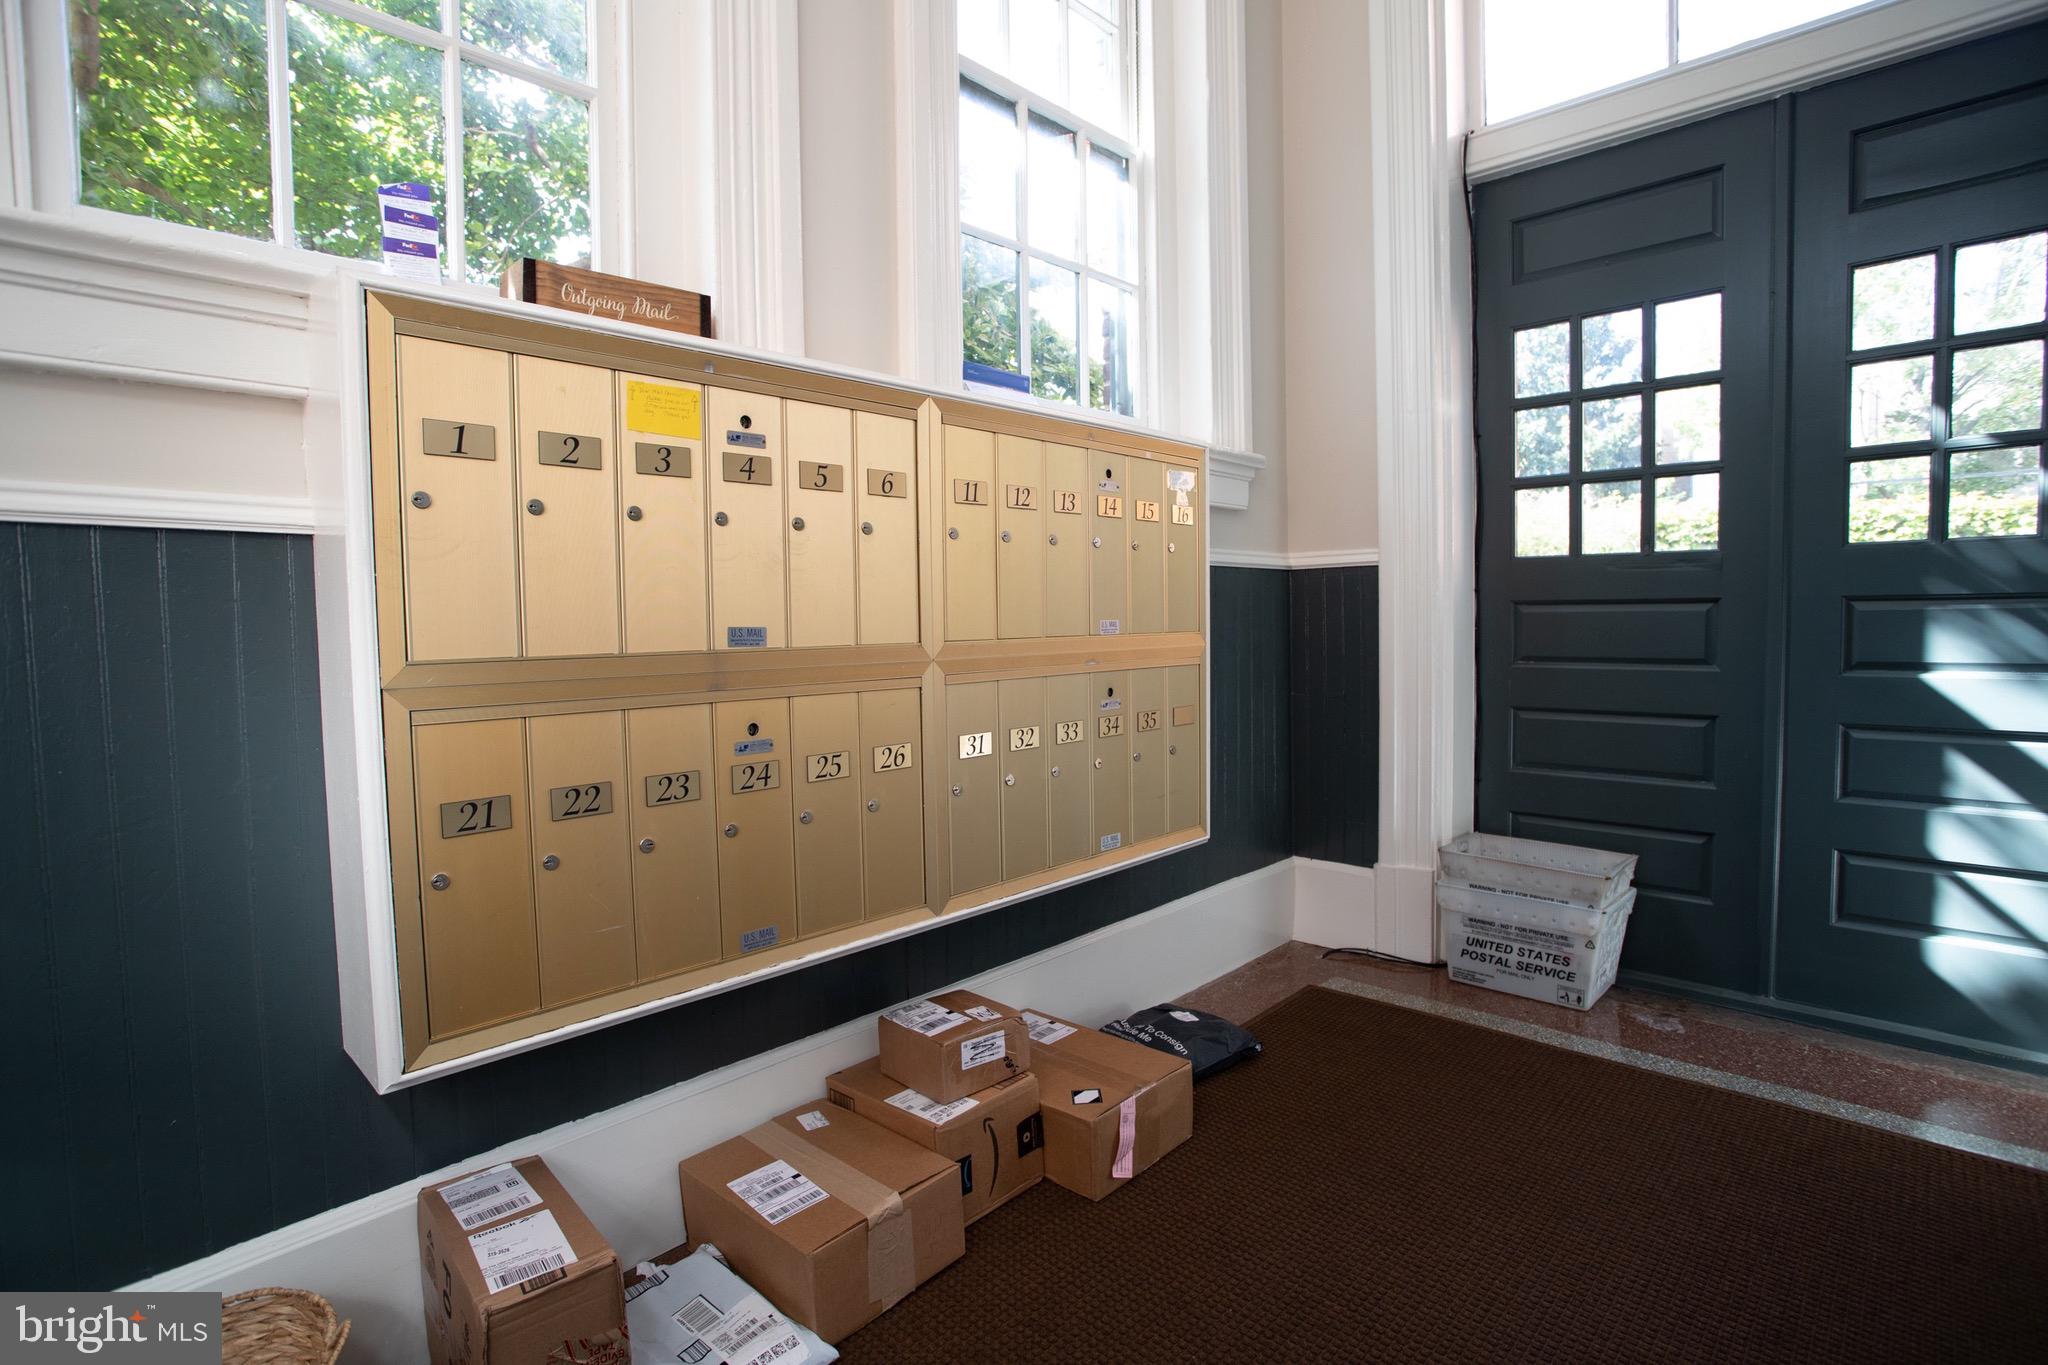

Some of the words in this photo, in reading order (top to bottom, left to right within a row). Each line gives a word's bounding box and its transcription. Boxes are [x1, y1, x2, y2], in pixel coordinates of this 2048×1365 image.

[561, 282, 626, 320] Outgoing
[632, 296, 679, 320] Mail
[450, 425, 468, 454] 1
[559, 436, 580, 464] 2
[654, 447, 672, 473] 3
[739, 457, 756, 481] 4
[814, 464, 829, 488] 5
[881, 472, 894, 495] 6
[962, 481, 979, 503] 11
[1013, 487, 1031, 507] 12
[1061, 492, 1076, 512] 13
[1103, 497, 1118, 516] 14
[1141, 502, 1155, 519] 15
[1177, 507, 1189, 523] 16
[746, 628, 764, 638] MAIL
[1061, 722, 1079, 742] 33
[1102, 716, 1120, 736] 34
[1141, 712, 1157, 729] 35
[966, 734, 984, 756] 31
[1015, 728, 1035, 749] 32
[815, 753, 842, 779] 25
[880, 745, 905, 769] 26
[655, 773, 690, 802] 23
[740, 763, 772, 790] 24
[562, 786, 601, 816] 22
[457, 800, 497, 832] 21
[1501, 923, 1513, 931] NOT
[1528, 929, 1554, 939] PRIVATE
[1466, 936, 1513, 955] UNITED
[1517, 947, 1571, 967] STATES
[1460, 948, 1512, 969] POSTAL
[1515, 960, 1576, 982] SERVICE
[1138, 1031, 1152, 1042] Me
[1144, 1025, 1155, 1033] To
[1154, 1030, 1188, 1056] Consign
